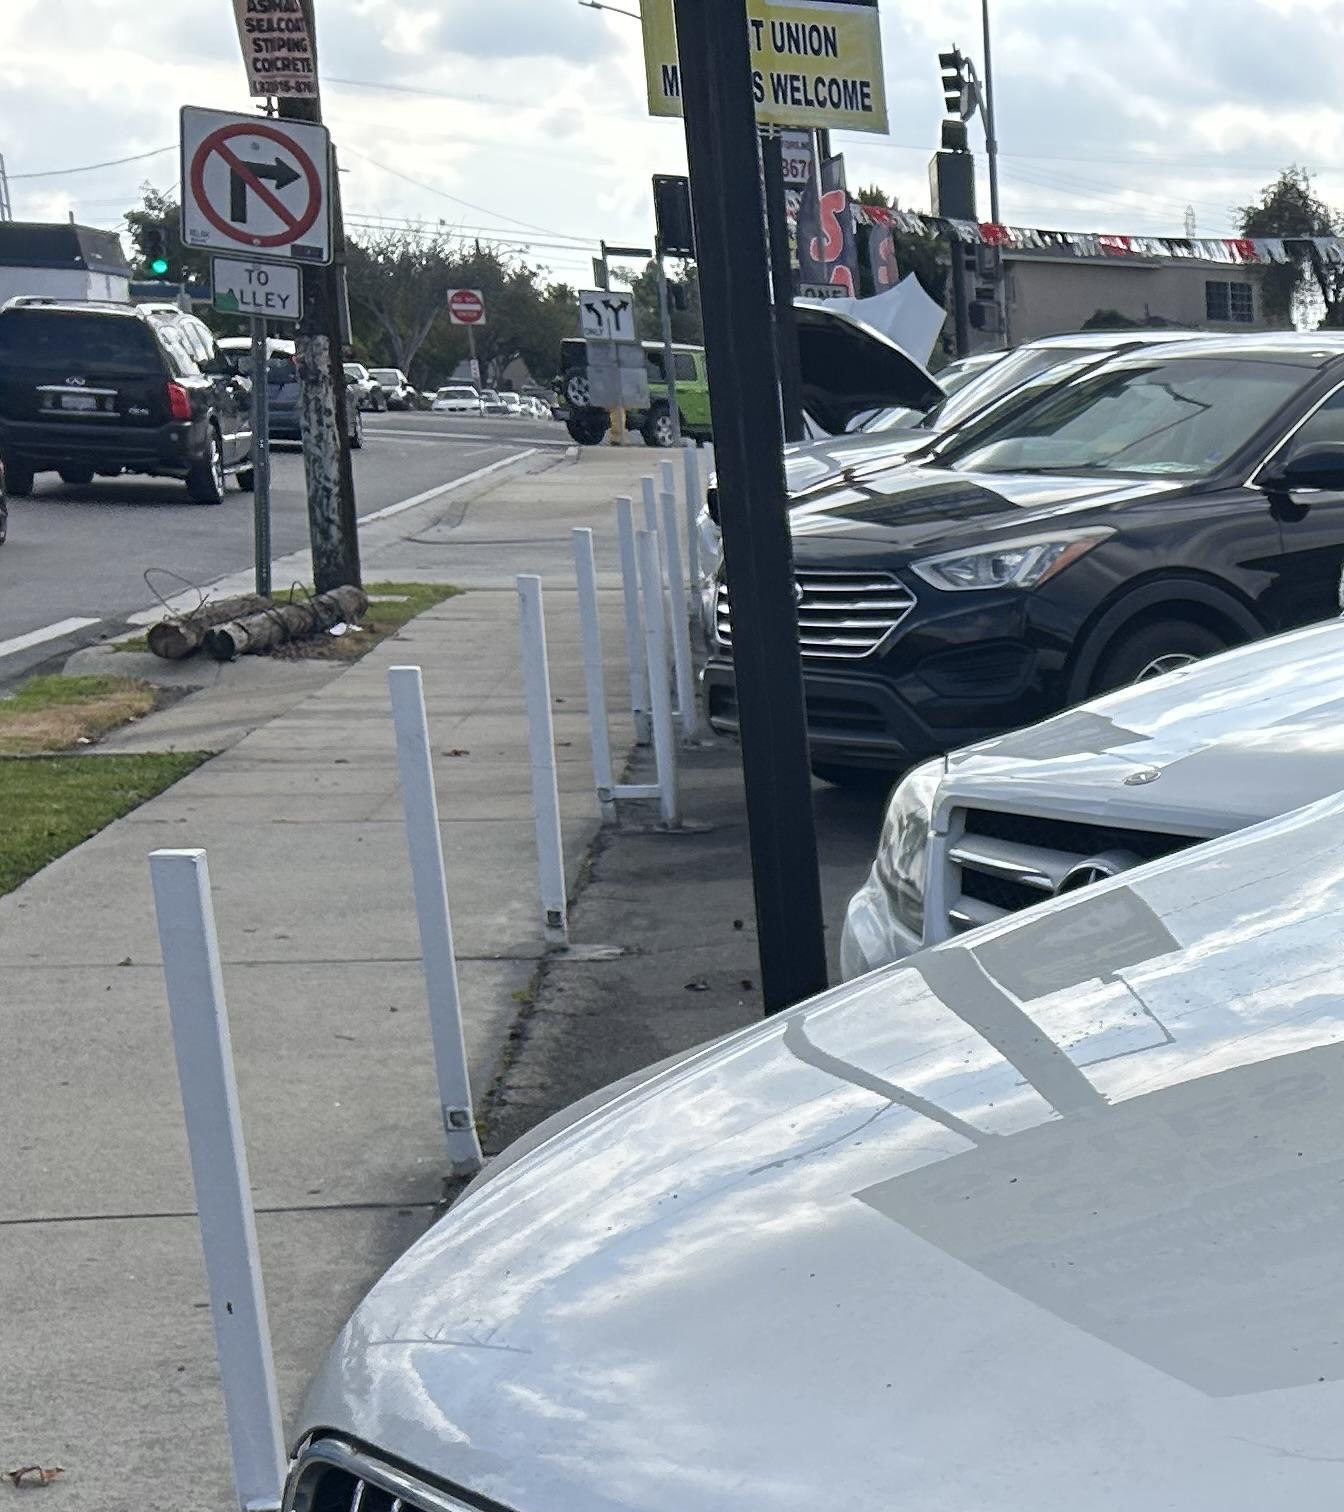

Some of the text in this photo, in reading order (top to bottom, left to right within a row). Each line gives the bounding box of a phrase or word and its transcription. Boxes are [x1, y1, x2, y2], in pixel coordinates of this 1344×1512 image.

[771, 21, 838, 58] UNION
[770, 72, 873, 112] WELCOME
[245, 268, 269, 287] TO
[226, 287, 291, 309] ALLEY
